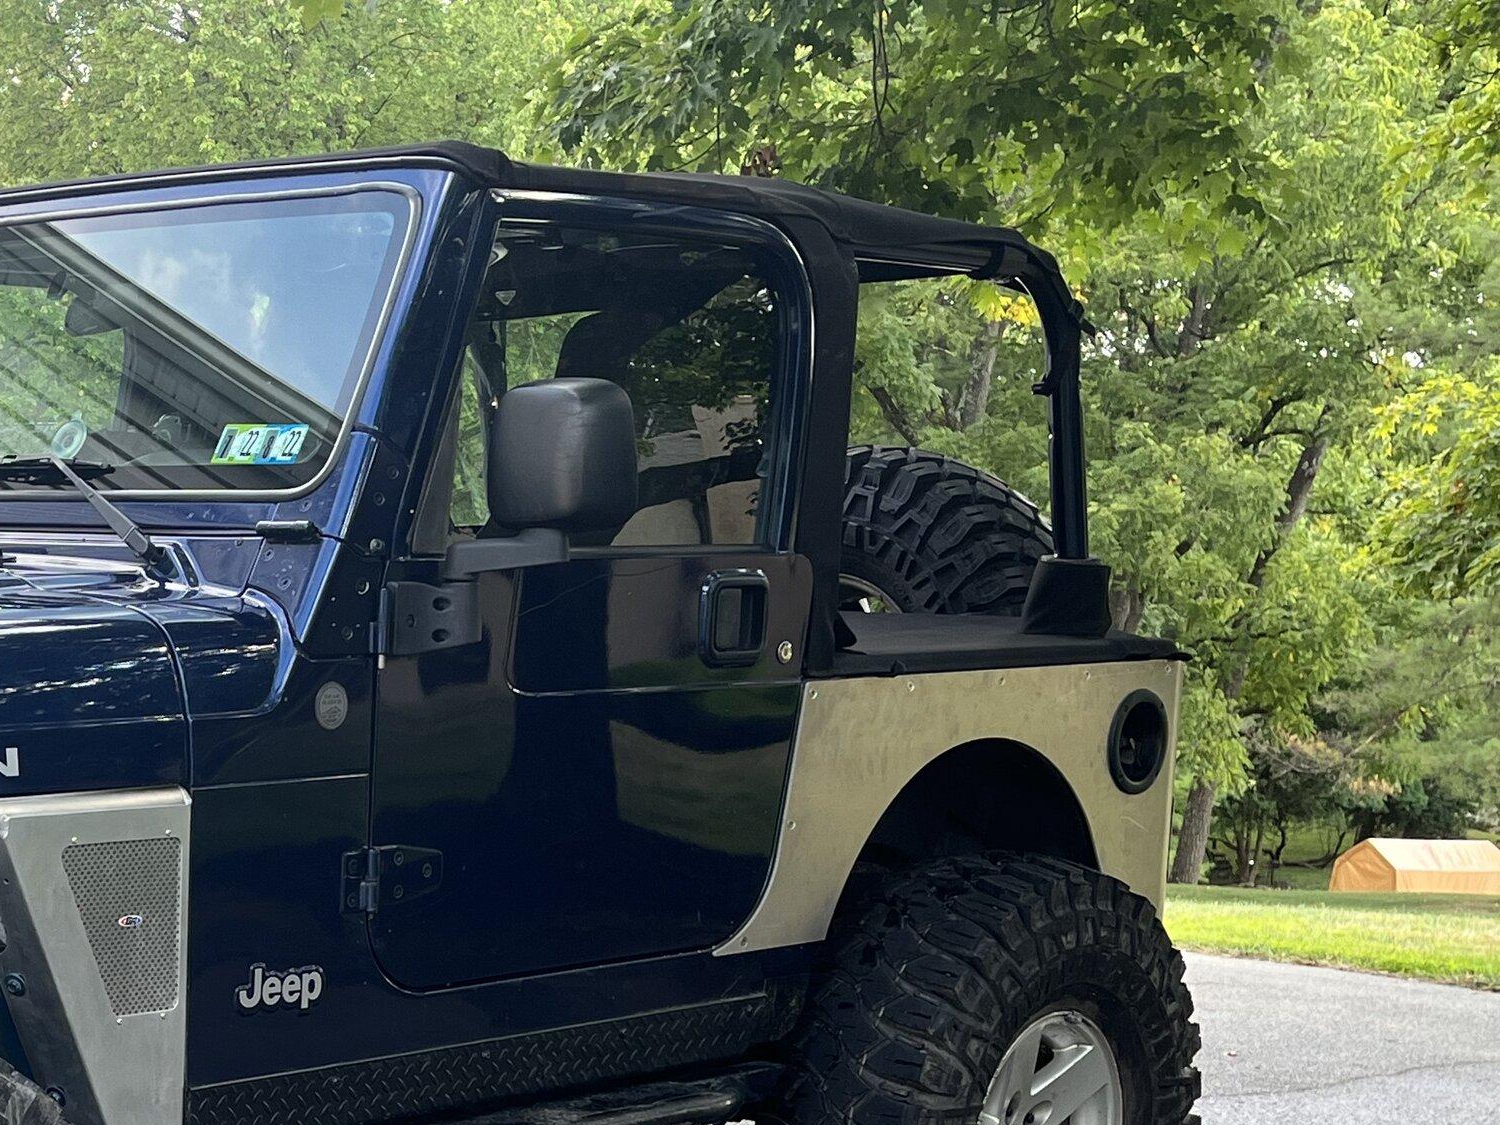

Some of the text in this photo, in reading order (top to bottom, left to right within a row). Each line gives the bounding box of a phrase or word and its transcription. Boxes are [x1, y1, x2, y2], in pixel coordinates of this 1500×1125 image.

[240, 430, 260, 457] 22
[262, 435, 275, 459] 8
[281, 430, 302, 457] 22
[237, 963, 322, 1009] Jeep
